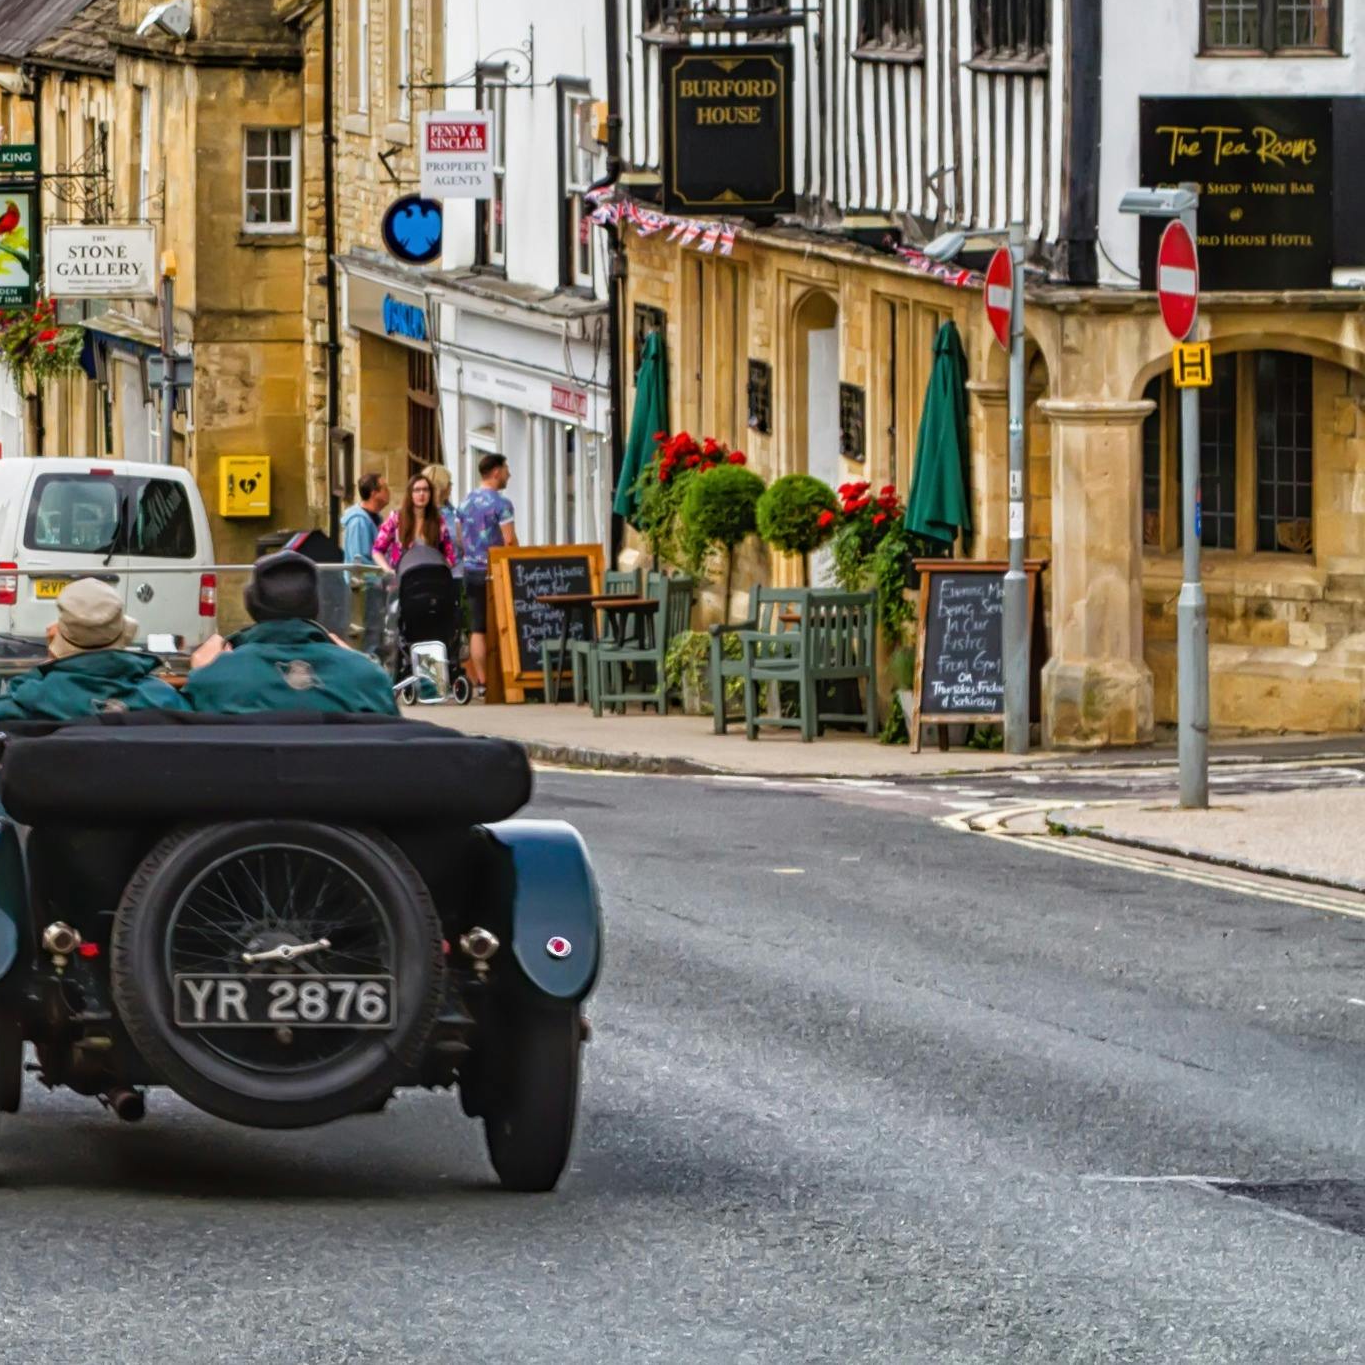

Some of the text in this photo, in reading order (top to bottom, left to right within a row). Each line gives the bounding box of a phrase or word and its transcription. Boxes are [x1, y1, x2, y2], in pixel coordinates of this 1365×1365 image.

[679, 79, 777, 97] BURFORD
[696, 106, 761, 124] HOUSE
[430, 125, 478, 137] PENNY &
[430, 137, 483, 149] SINCLAIR
[1155, 125, 1317, 167] The Tea Rooms
[2, 152, 32, 162] KING
[426, 162, 487, 172] PROPERTY
[434, 176, 482, 185] AGENTS
[68, 245, 127, 259] STONE
[56, 262, 143, 276] GALLERY
[183, 979, 387, 1022] YR 2876
